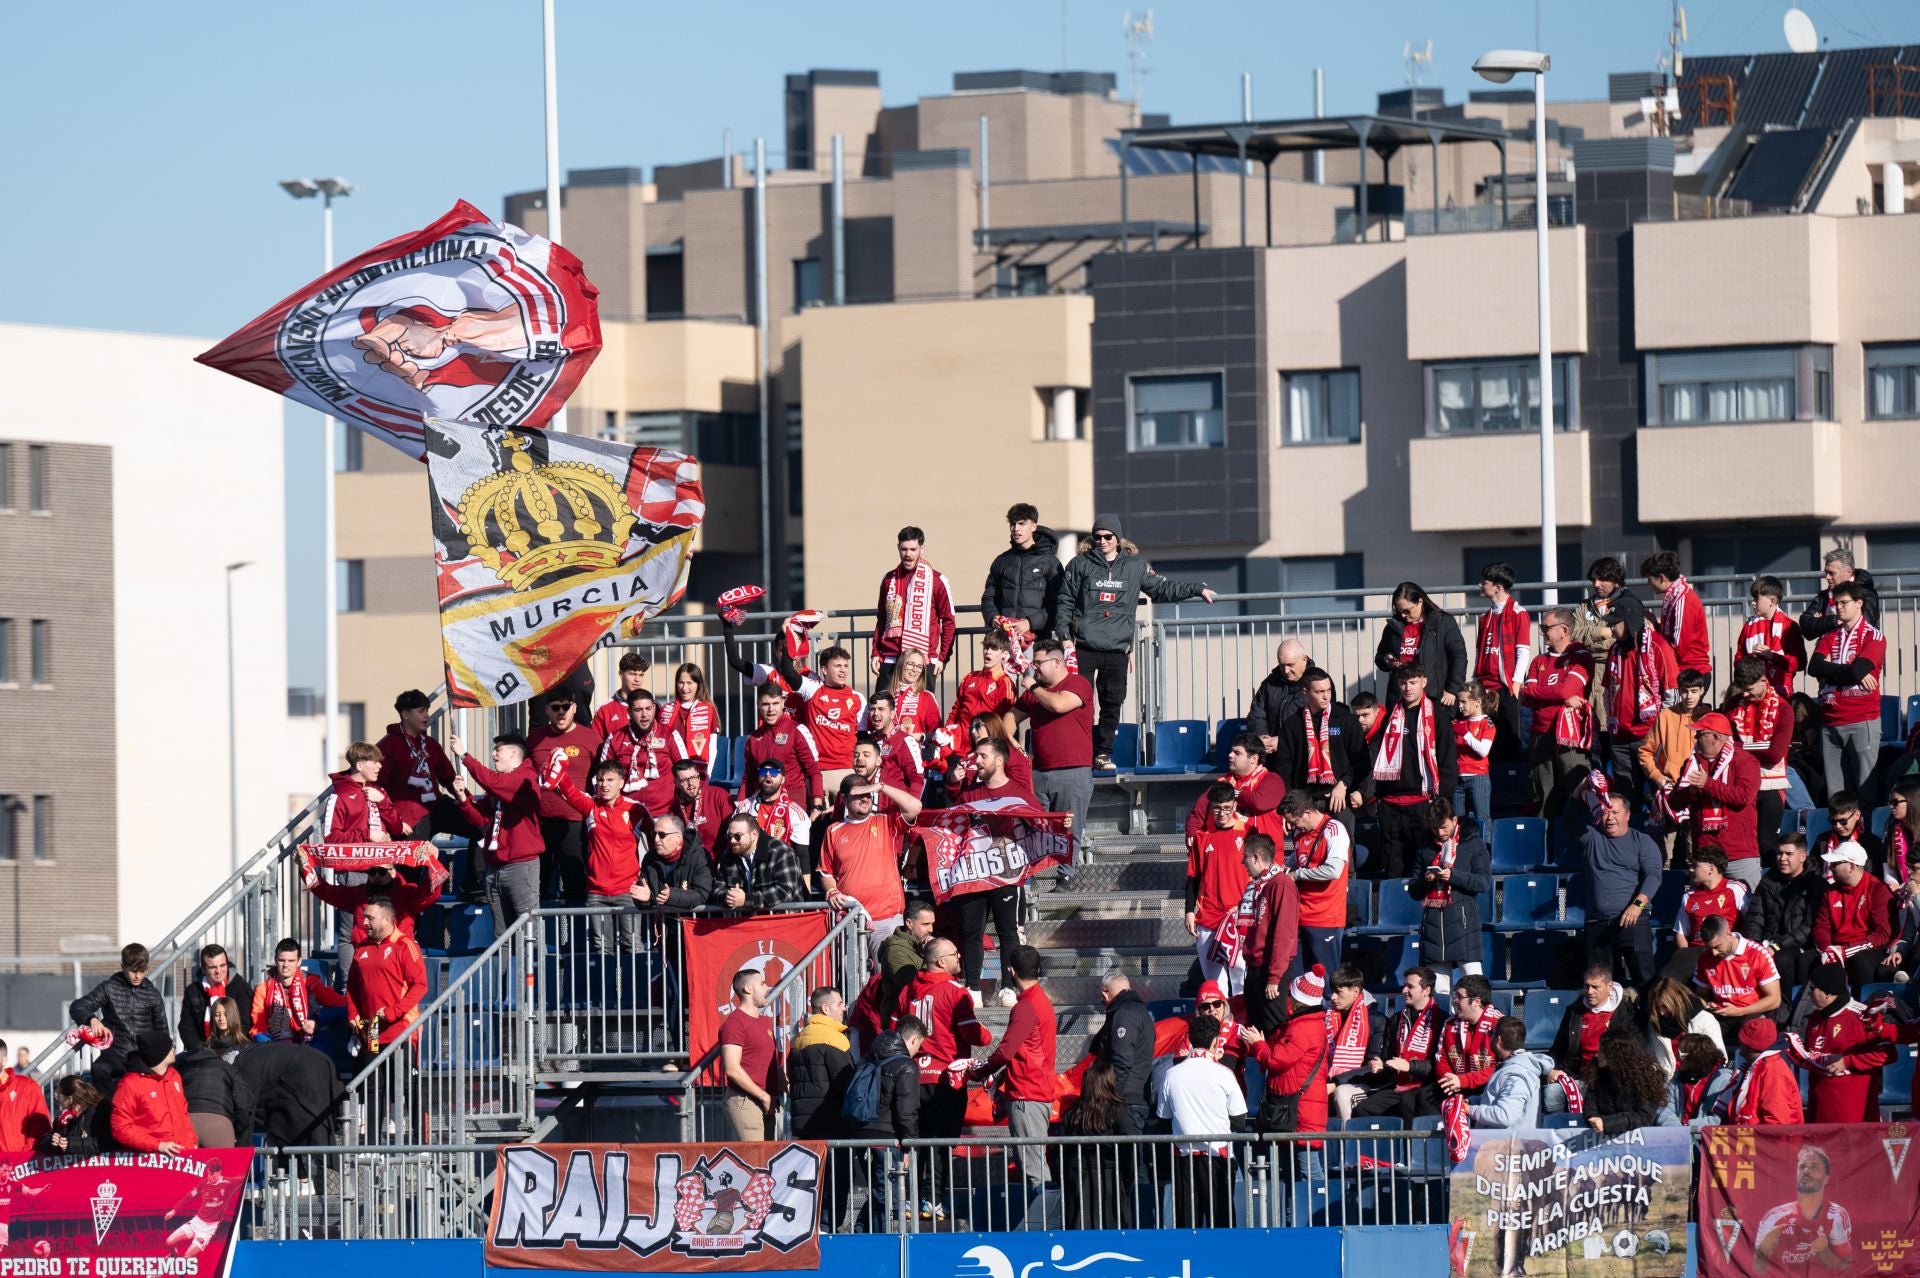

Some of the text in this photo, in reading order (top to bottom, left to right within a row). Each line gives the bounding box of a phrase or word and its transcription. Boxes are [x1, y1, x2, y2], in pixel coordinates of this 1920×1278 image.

[471, 364, 545, 425] DESDE
[489, 575, 649, 642] MURCIA
[815, 714, 851, 733] fibranet
[306, 846, 413, 858] REAL MURCIA
[757, 939, 775, 955] EL
[113, 1152, 134, 1166] MI
[138, 1153, 207, 1178] CAPITÁN
[1494, 1128, 1645, 1173] SIEMPRE HACIA
[1476, 1154, 1664, 1201] DELANTE AUNQUE
[1487, 1184, 1650, 1230] PESE LA CUESTA
[1530, 1217, 1603, 1257] ARRIBA
[1, 1257, 199, 1278] PEDRO TE QUEREMOS
